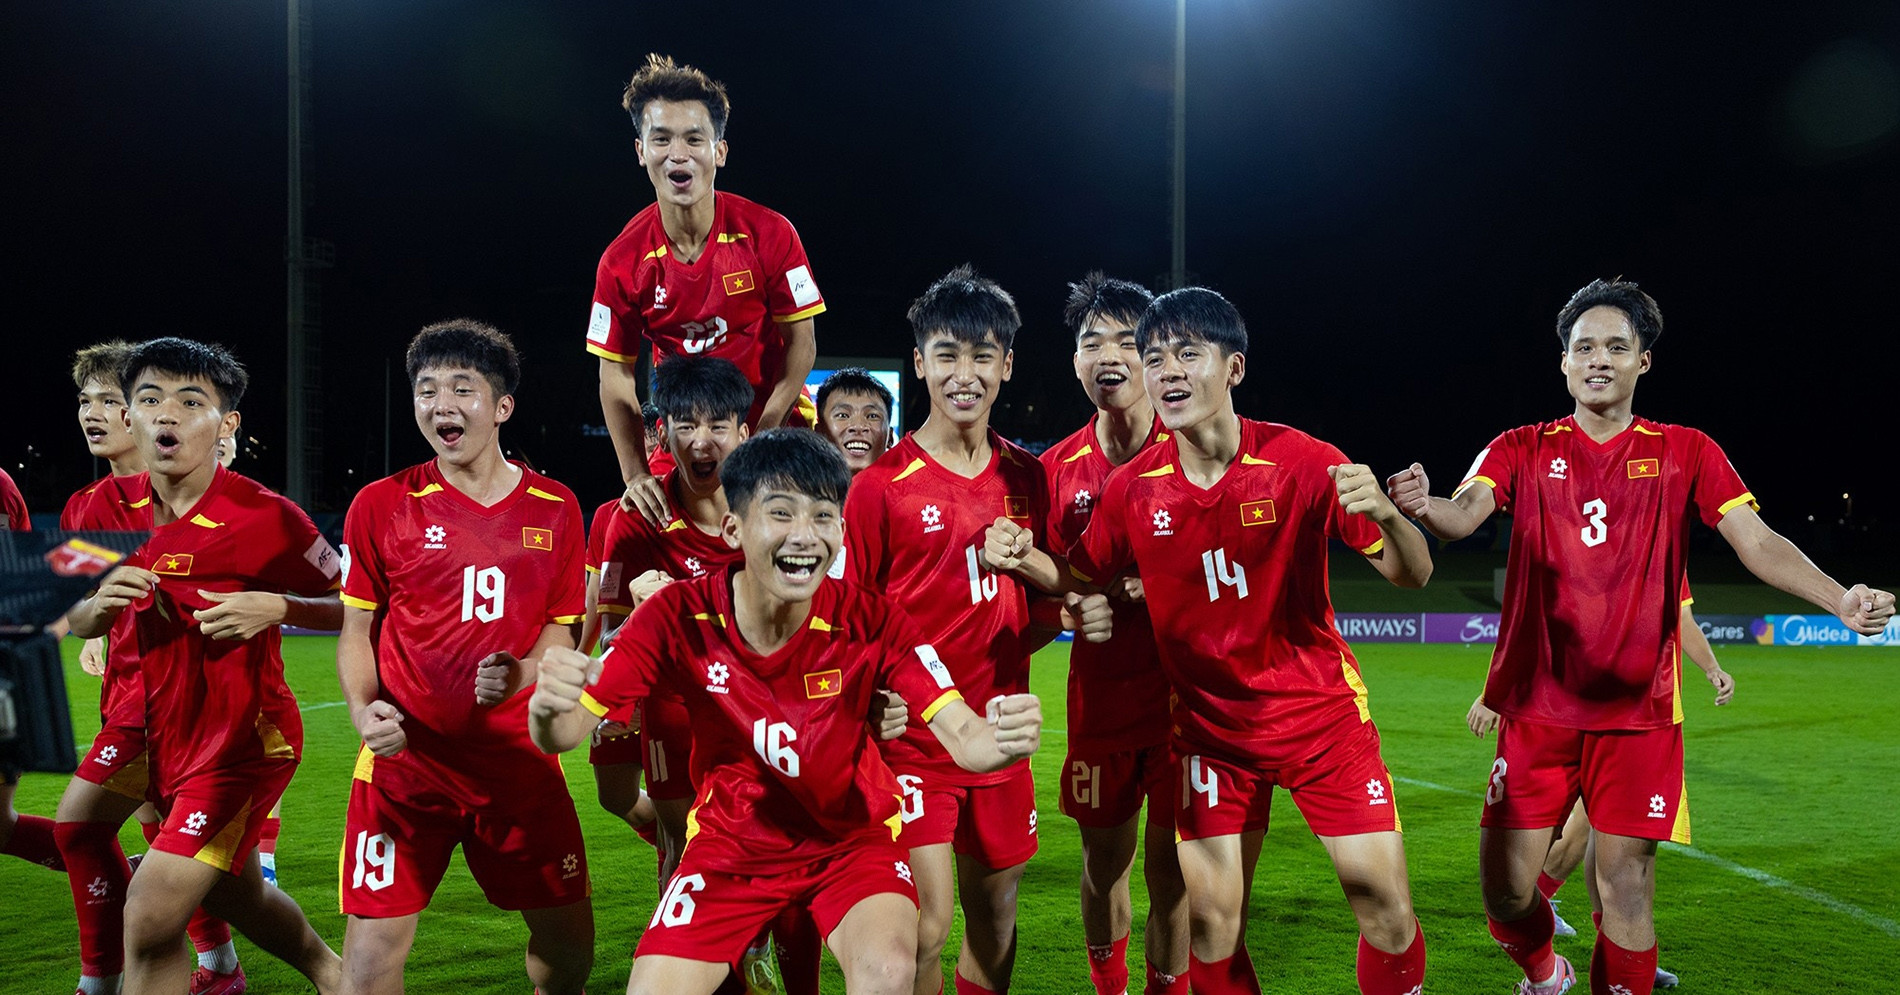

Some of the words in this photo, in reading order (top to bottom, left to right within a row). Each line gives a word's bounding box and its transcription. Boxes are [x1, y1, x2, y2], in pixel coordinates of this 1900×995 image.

[1581, 497, 1607, 547] 3
[461, 565, 505, 623] 19
[1202, 547, 1249, 602] 14
[1335, 618, 1417, 637] AIRWAYS
[1460, 616, 1499, 642] Sa
[1700, 622, 1744, 639] Cares
[1790, 621, 1850, 642] Midea
[649, 739, 668, 783] 11
[753, 717, 800, 778] 16
[1072, 760, 1101, 809] 21
[1183, 755, 1219, 809] 14
[1486, 756, 1508, 806] 3
[352, 830, 396, 891] 19
[649, 873, 706, 930] 16
